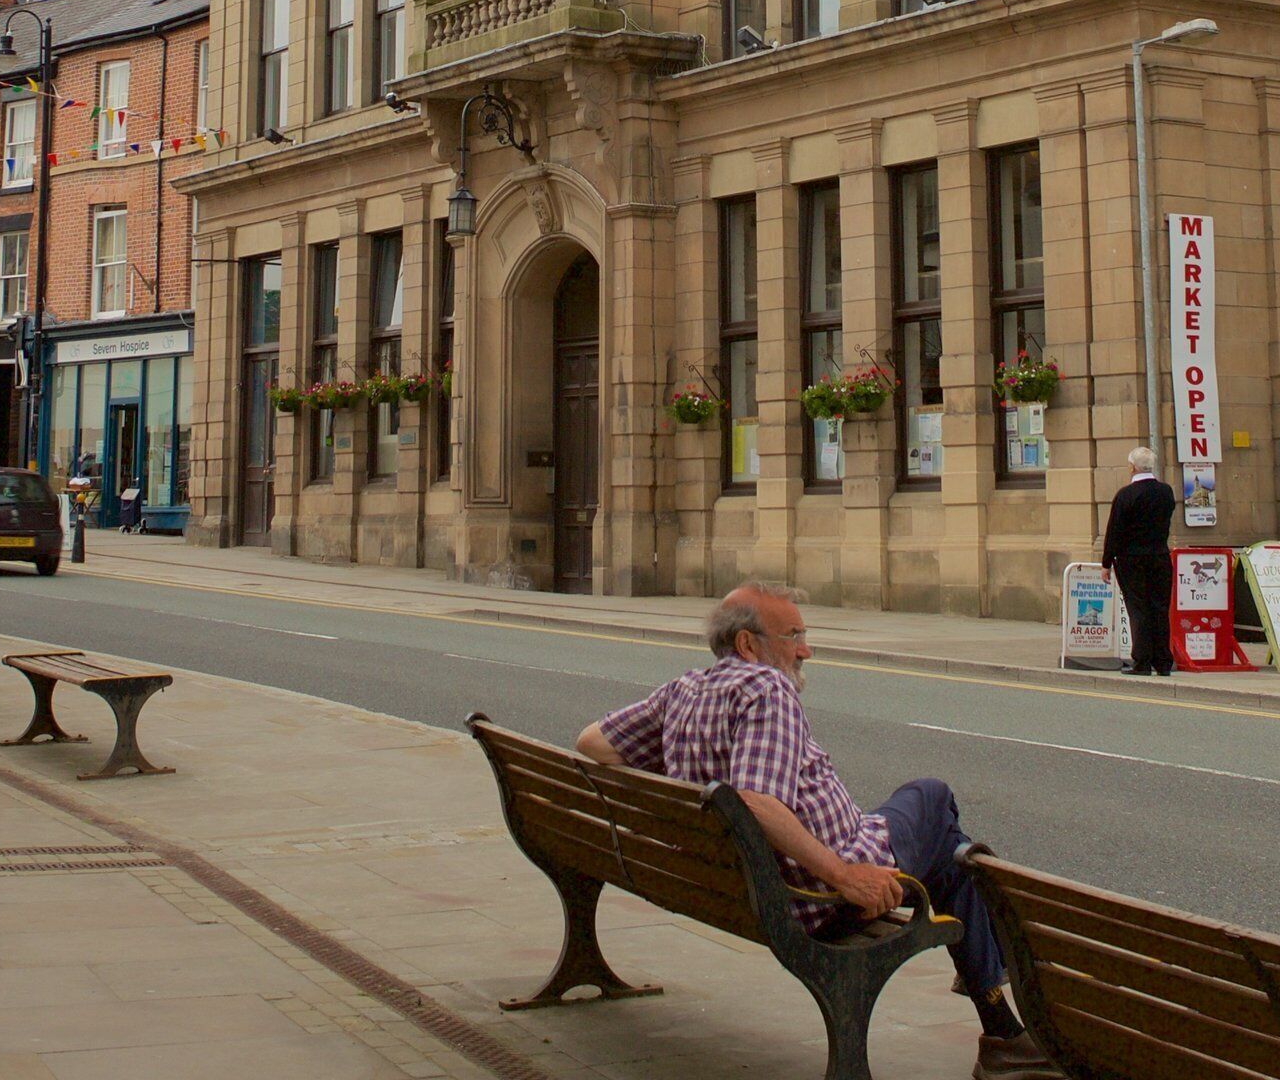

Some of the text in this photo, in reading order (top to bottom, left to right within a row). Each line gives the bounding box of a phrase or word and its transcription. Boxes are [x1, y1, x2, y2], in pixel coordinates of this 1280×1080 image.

[1180, 216, 1203, 355] MARKET
[92, 340, 150, 355] Severn Hospice
[1184, 366, 1209, 458] OPEN
[1070, 626, 1109, 635] AR AGOR
